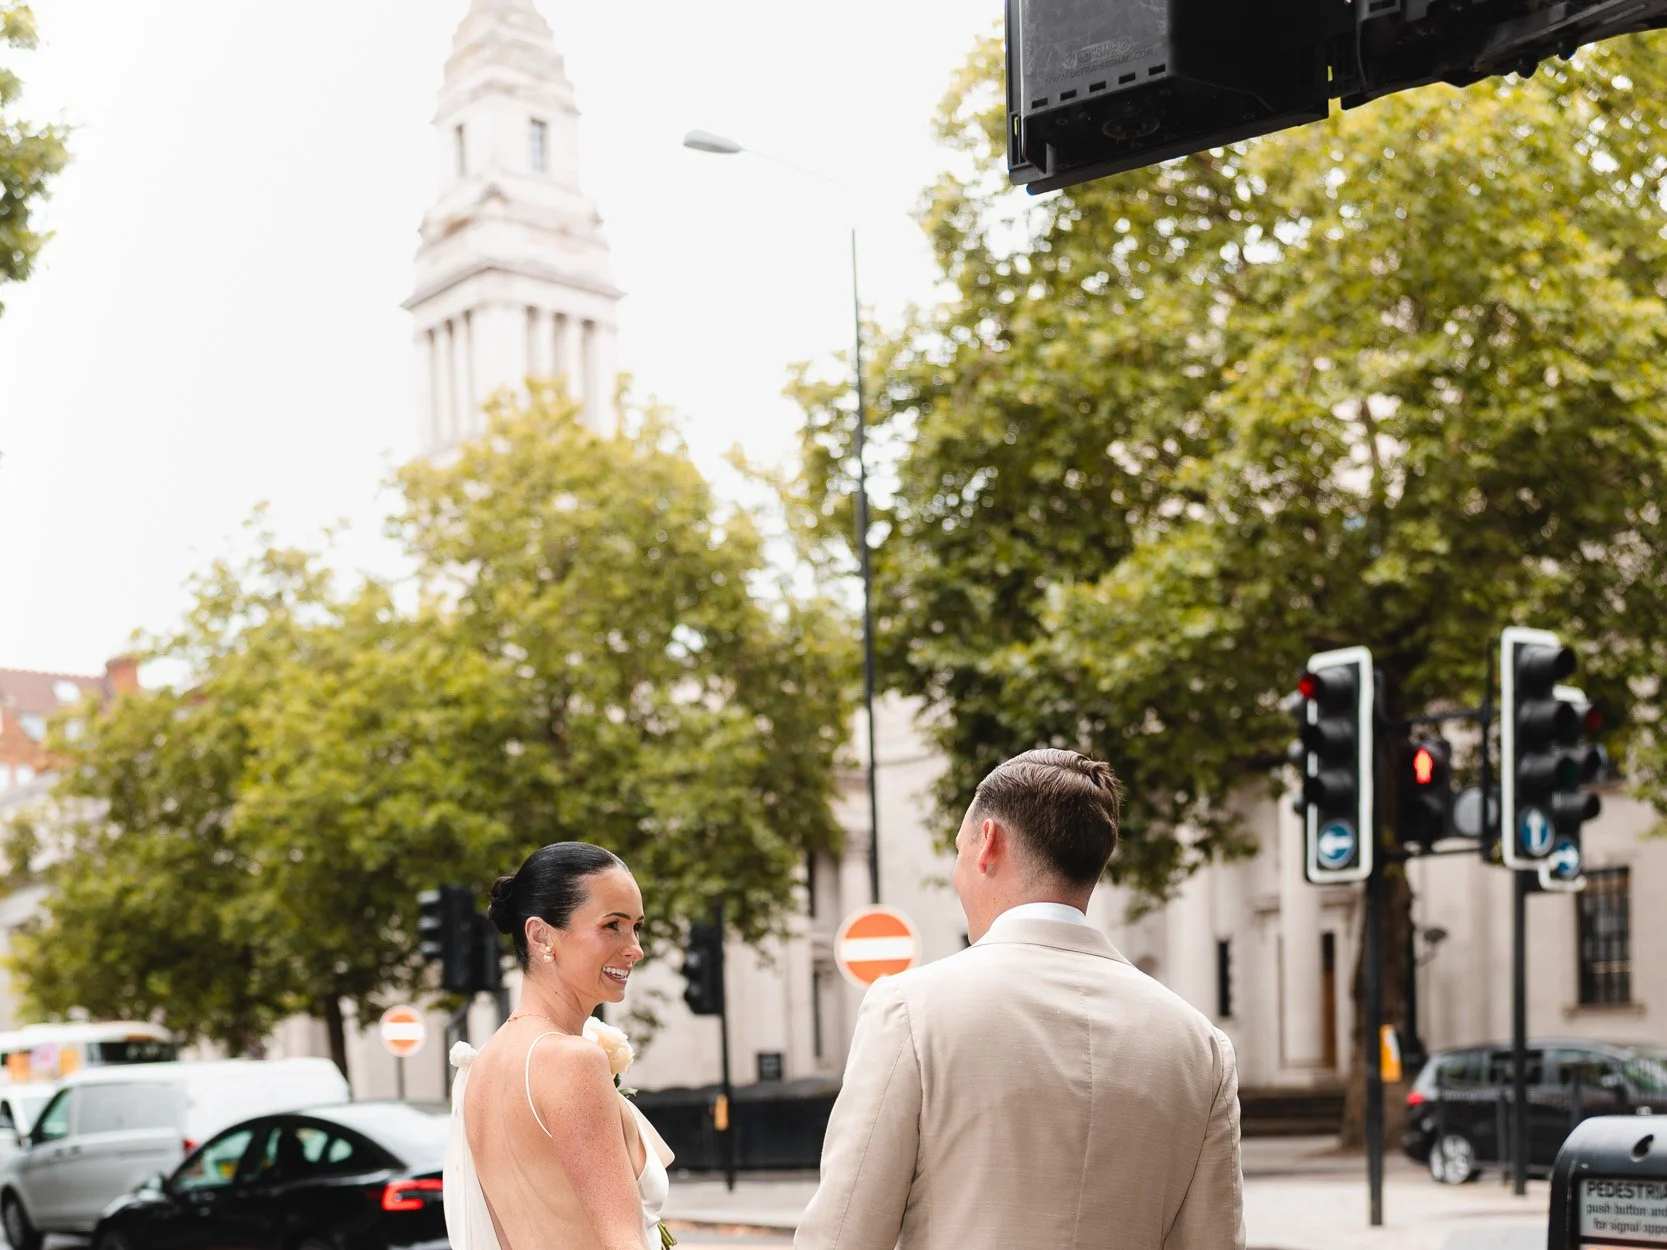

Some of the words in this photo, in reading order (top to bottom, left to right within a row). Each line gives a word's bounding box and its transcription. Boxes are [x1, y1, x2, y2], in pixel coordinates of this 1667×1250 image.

[1586, 1203, 1610, 1215] push
[1614, 1203, 1646, 1216] button
[1593, 1219, 1607, 1230] for
[1609, 1221, 1641, 1234] signal
